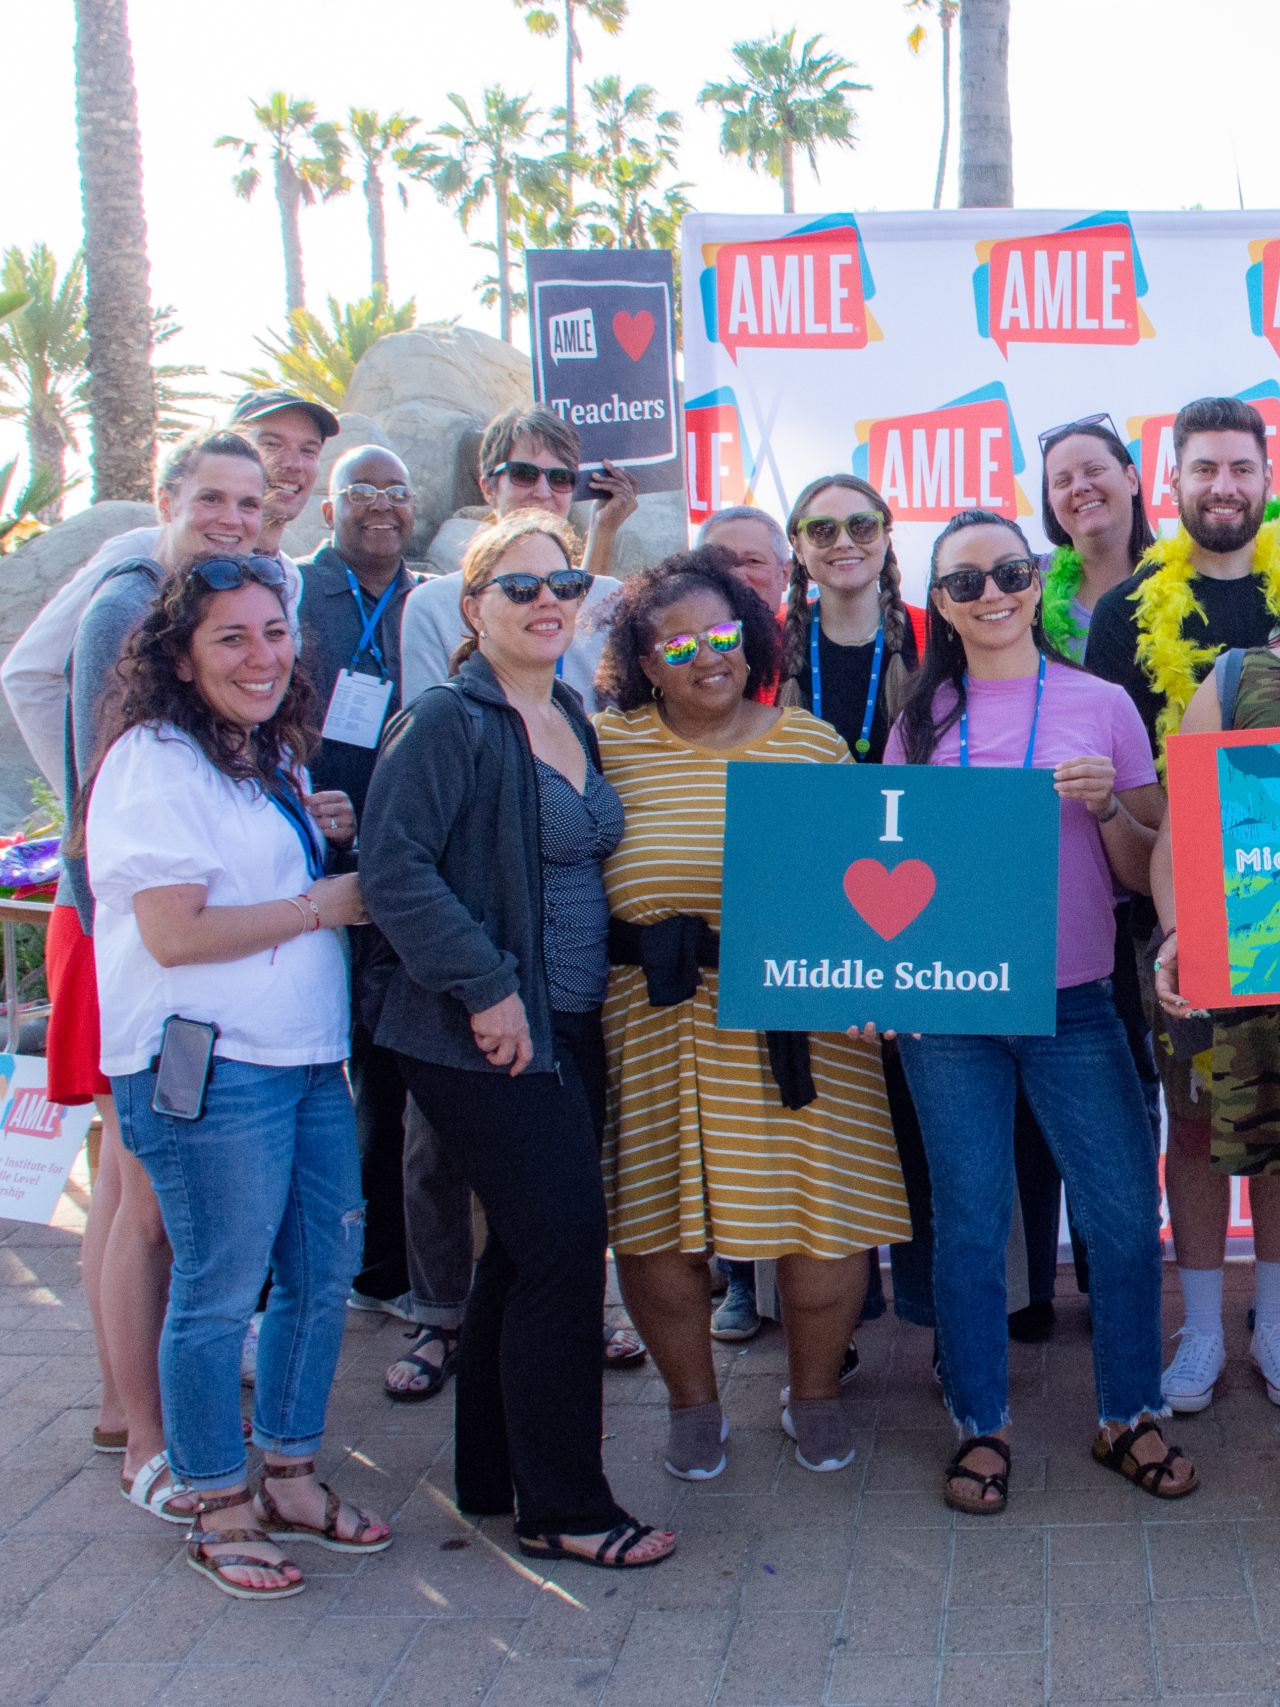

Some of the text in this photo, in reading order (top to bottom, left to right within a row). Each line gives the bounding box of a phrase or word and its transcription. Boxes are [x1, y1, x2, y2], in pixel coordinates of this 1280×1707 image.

[729, 254, 854, 334] AMLE
[1002, 250, 1127, 330] AMLE
[554, 319, 593, 354] AMLE
[551, 393, 666, 425] Teachers
[687, 431, 734, 511] LE
[880, 427, 1004, 508] AMLE
[879, 789, 905, 842] I
[763, 958, 1011, 992] Middle School
[8, 1092, 59, 1133] AMLE
[4, 1156, 47, 1172] Institute
[48, 1162, 65, 1174] for
[13, 1172, 41, 1186] Level
